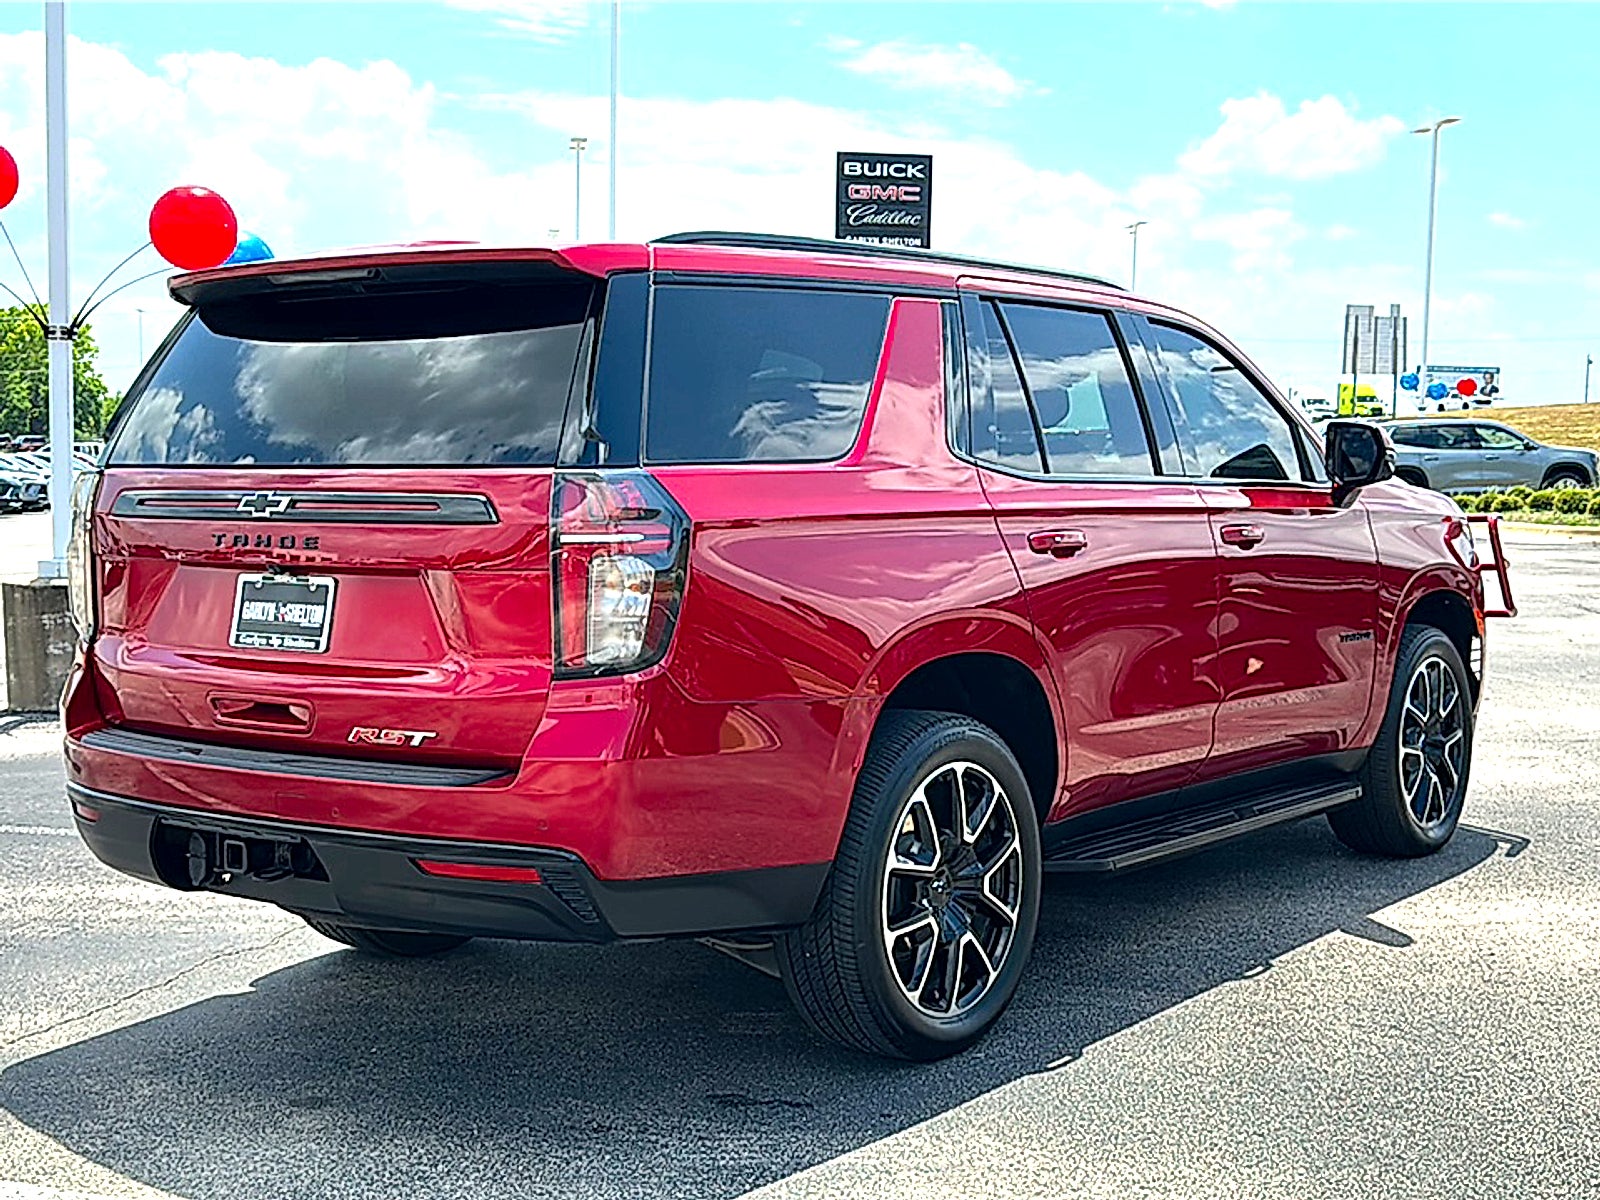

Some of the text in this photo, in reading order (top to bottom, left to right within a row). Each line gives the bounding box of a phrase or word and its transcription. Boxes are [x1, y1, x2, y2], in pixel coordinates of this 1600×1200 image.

[843, 161, 925, 179] BUICK
[848, 184, 921, 202] GMC
[846, 203, 922, 226] Cadillac
[211, 533, 320, 550] TAHOE
[347, 726, 437, 746] RST
